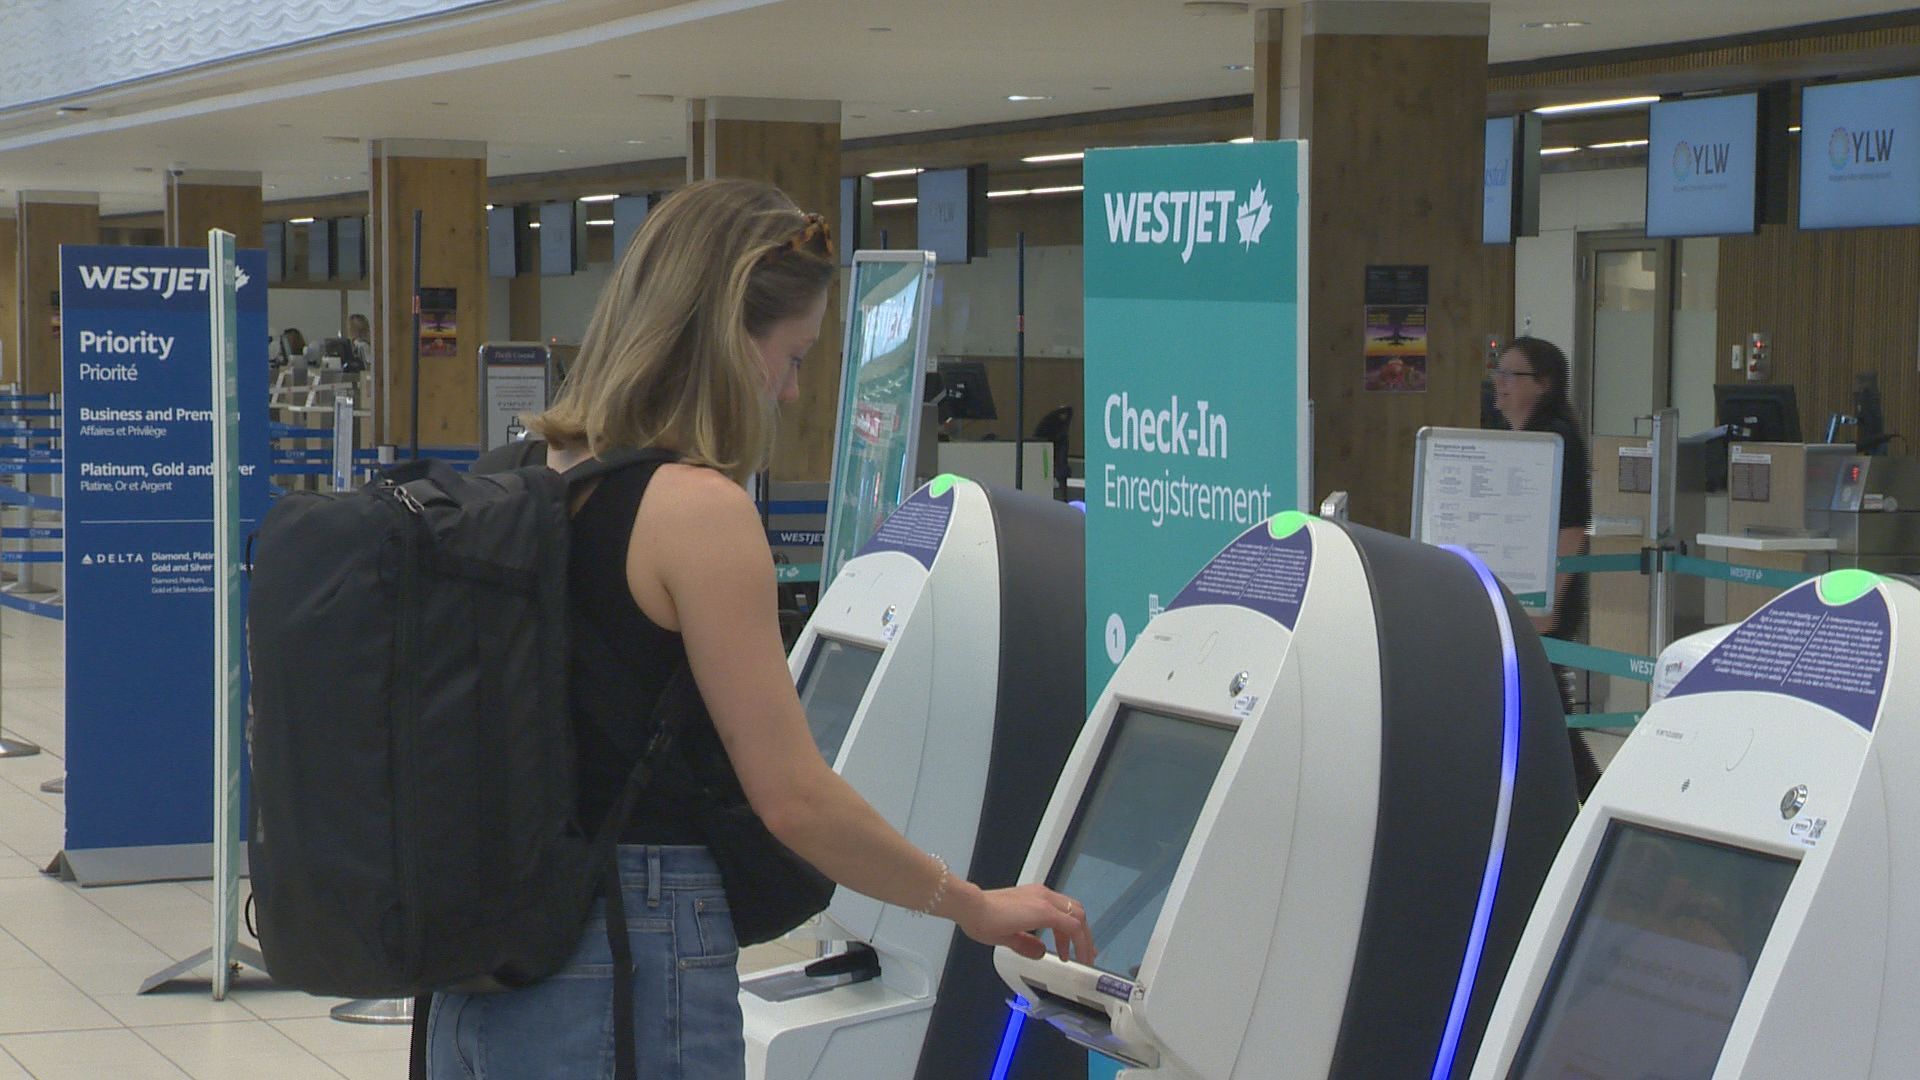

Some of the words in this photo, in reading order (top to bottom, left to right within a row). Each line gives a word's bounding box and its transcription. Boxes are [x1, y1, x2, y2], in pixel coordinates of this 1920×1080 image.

[1852, 128, 1895, 164] YLW
[1693, 143, 1730, 175] YLW
[1104, 190, 1236, 264] WESTJET
[79, 265, 210, 299] WESTJET
[80, 330, 175, 360] Priority
[80, 363, 139, 381] Priorité
[80, 407, 142, 421] Business
[145, 407, 173, 421] and
[176, 407, 241, 421] Prem
[80, 425, 114, 436] Affaires
[116, 426, 126, 436] et
[127, 424, 167, 438] Privilège
[1104, 391, 1228, 459] Check-In
[80, 462, 149, 478] Platinum,
[152, 462, 184, 476] Gold
[187, 462, 213, 476] and
[80, 480, 114, 492] Platine,
[115, 481, 128, 491] Or
[128, 481, 139, 491] et
[140, 481, 173, 494] Argent
[1104, 463, 1271, 527] Enregistrement
[97, 553, 144, 564] DELTA
[151, 552, 192, 562] Diamond,
[193, 552, 214, 561] Platin
[151, 563, 171, 573] Gold
[171, 563, 188, 573] and
[190, 563, 212, 573] Silver
[1630, 658, 1655, 676] WEST
